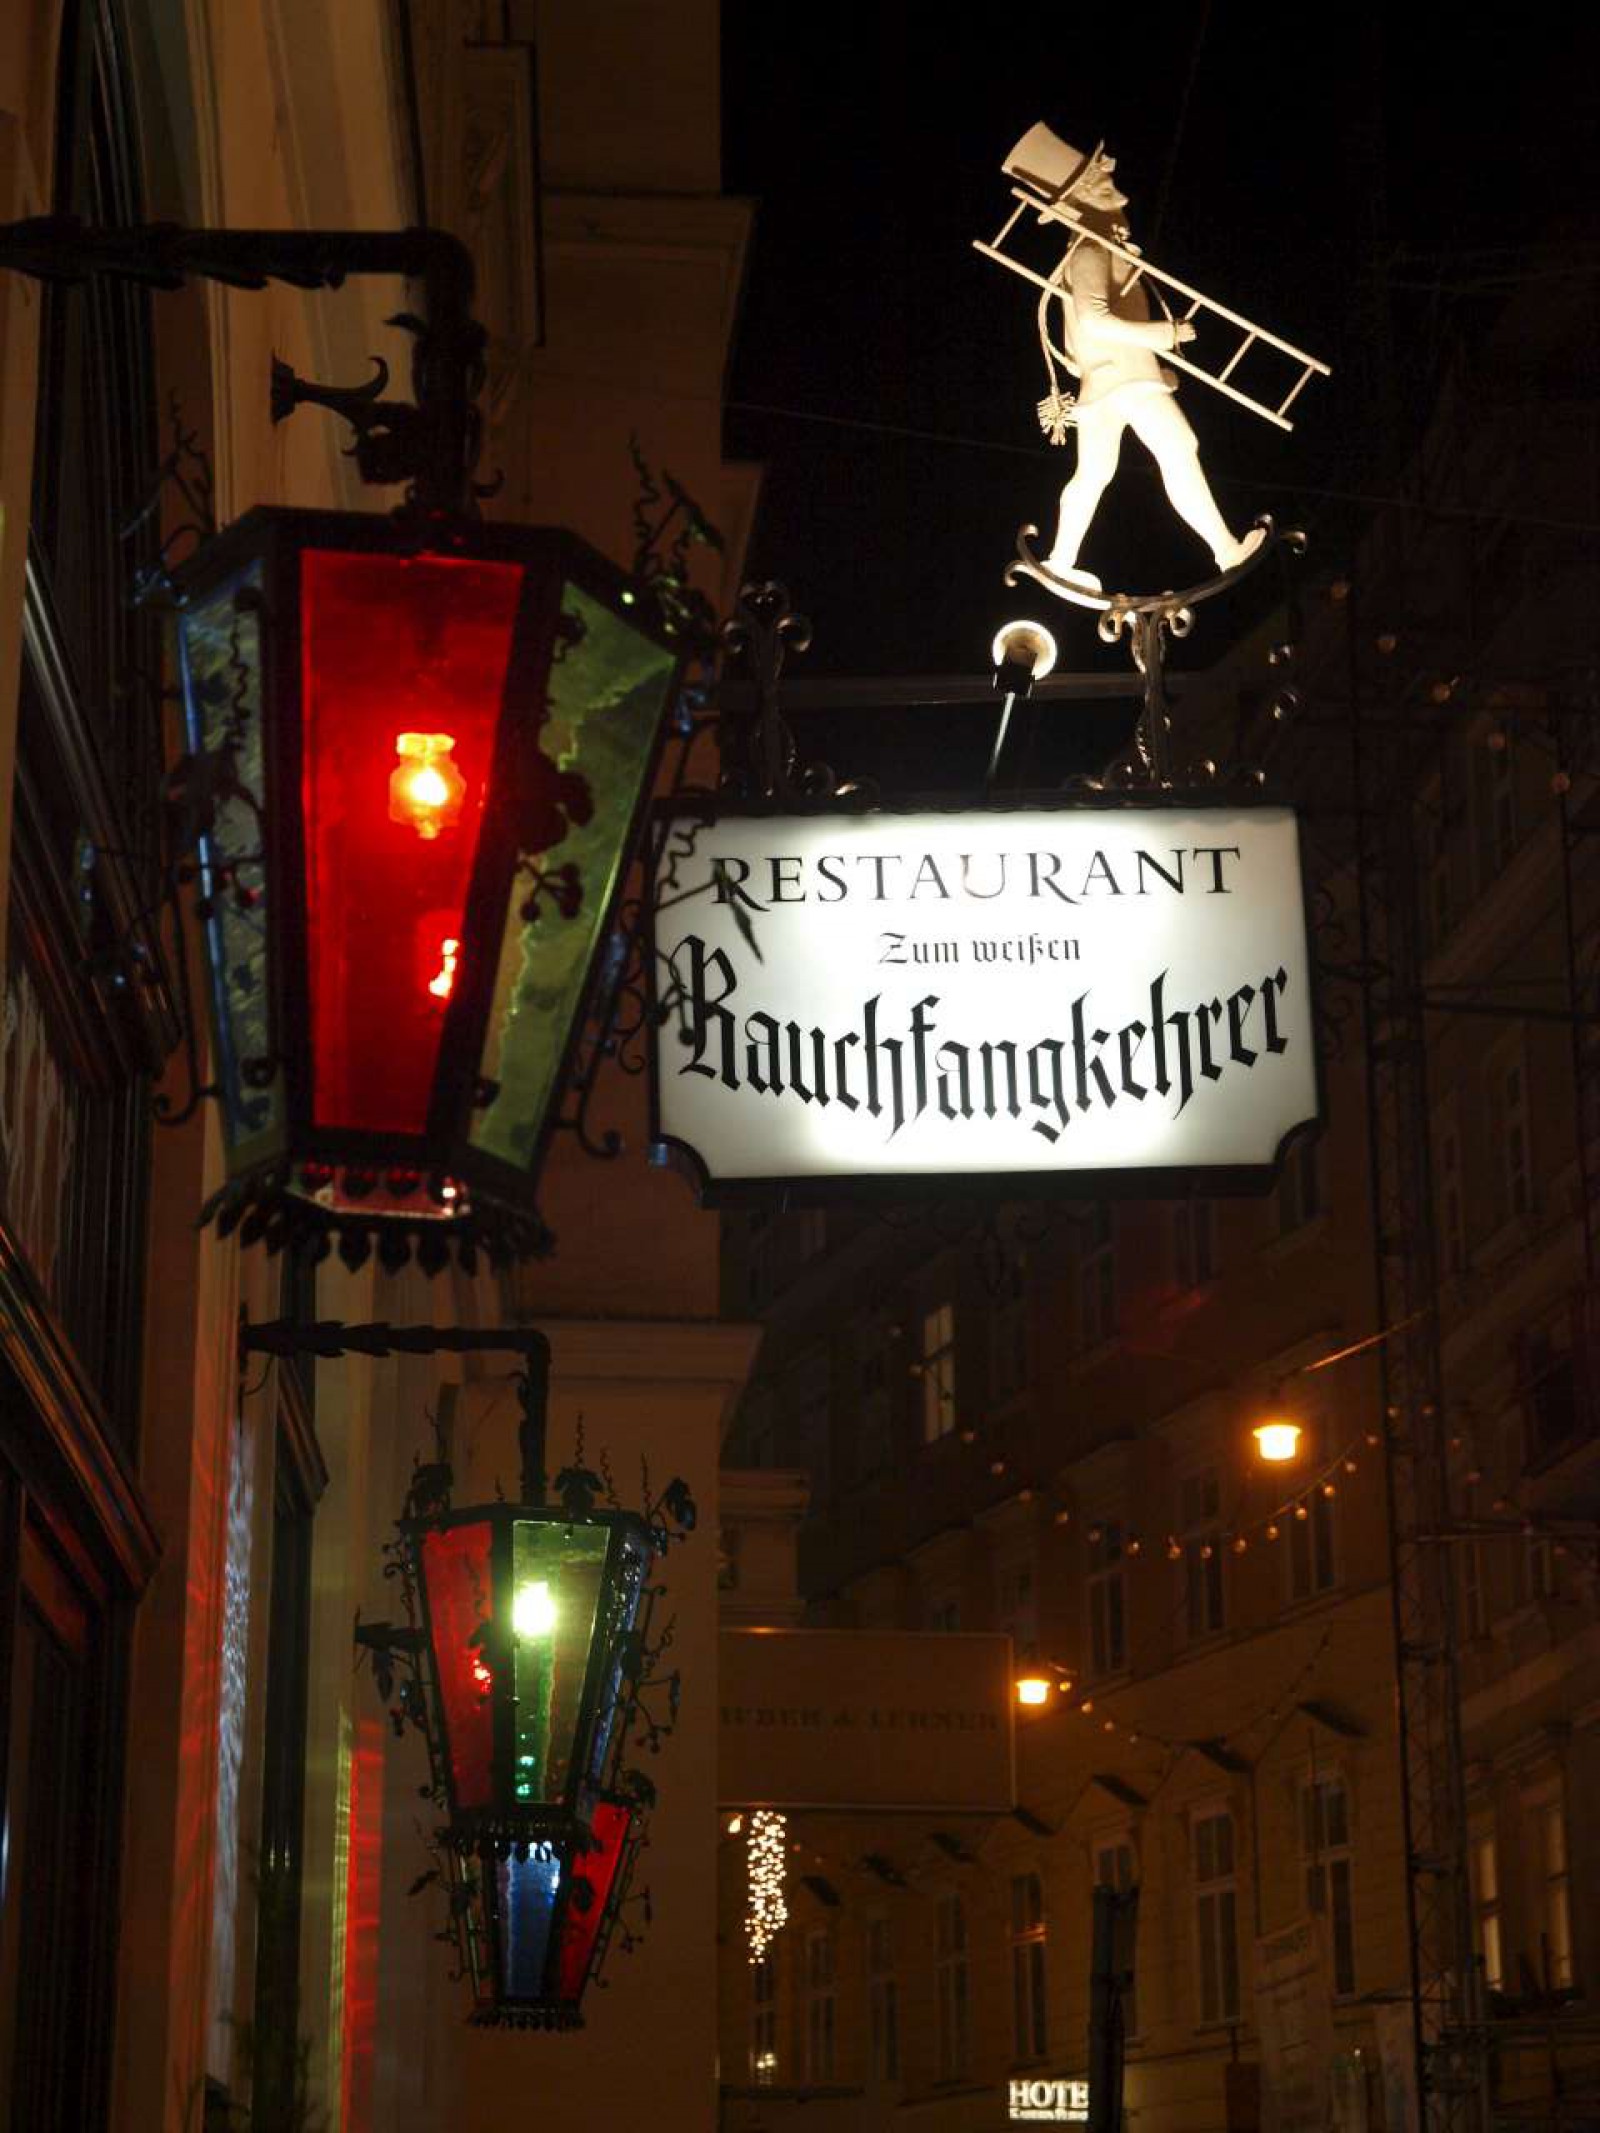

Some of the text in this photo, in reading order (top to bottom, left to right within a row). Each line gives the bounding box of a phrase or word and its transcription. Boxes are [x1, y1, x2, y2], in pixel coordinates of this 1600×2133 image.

[710, 847, 1241, 912] RESTAURANT
[880, 932, 1081, 966] Zum weißen
[678, 934, 1289, 1143] Rauchfangkehrer
